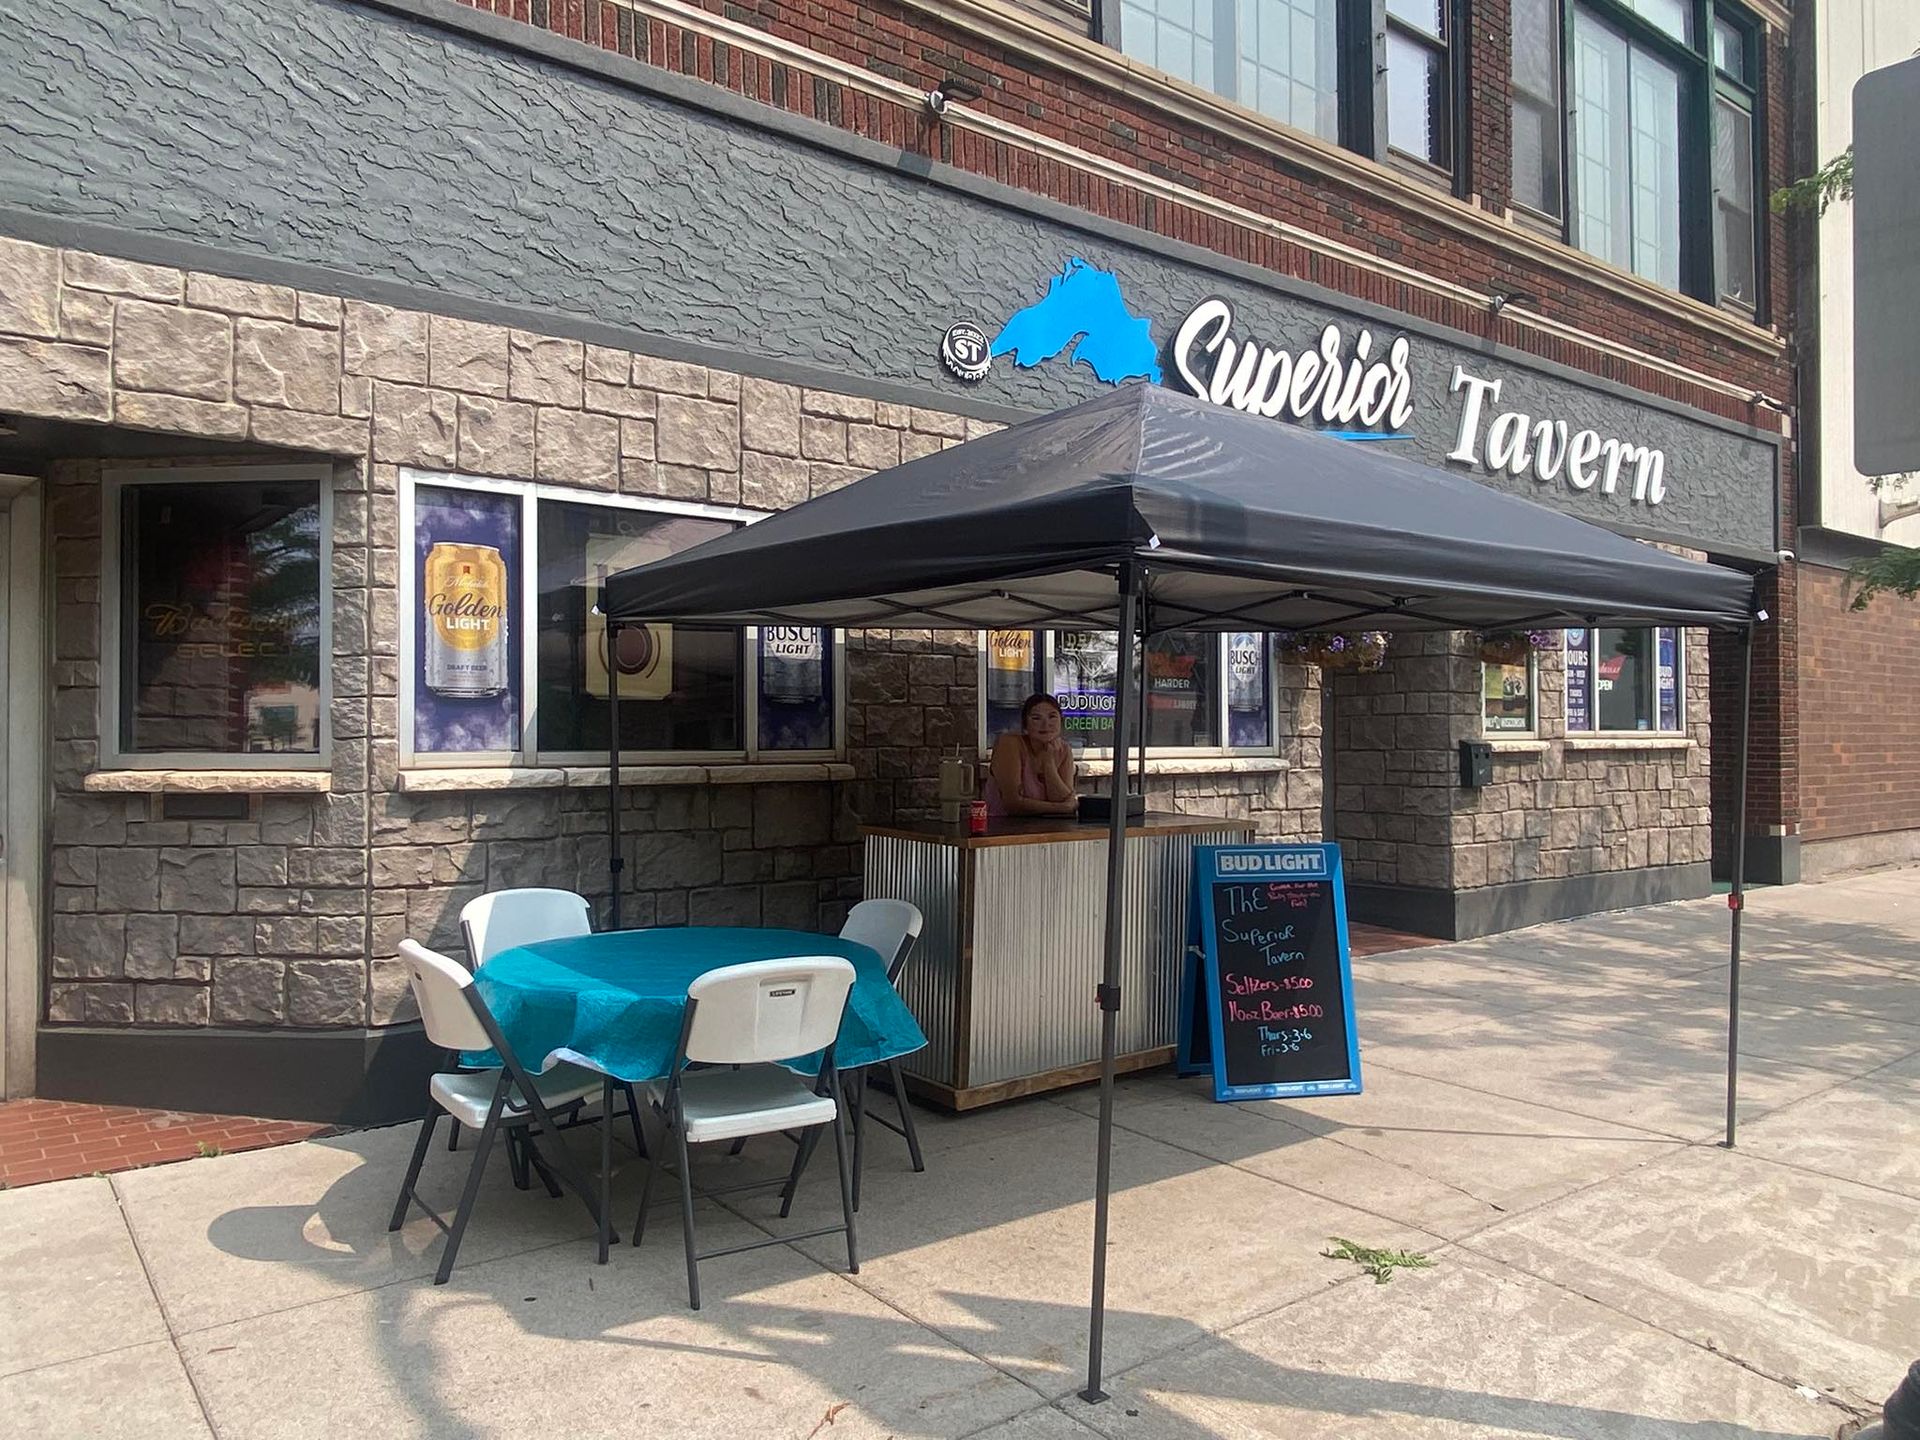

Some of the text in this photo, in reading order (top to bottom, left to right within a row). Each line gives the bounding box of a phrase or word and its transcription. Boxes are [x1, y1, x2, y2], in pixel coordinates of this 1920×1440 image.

[954, 338, 982, 362] ST
[1173, 298, 1414, 430] Superior
[1445, 364, 1666, 505] Tavern
[428, 592, 505, 619] Golden
[446, 617, 491, 631] LIGHT
[767, 626, 818, 644] BUSCH
[989, 630, 1031, 649] Golden
[775, 643, 811, 655] LIGHT
[999, 647, 1025, 658] LIGHT
[1568, 650, 1588, 666] OURS
[1235, 666, 1256, 676] LIGHT
[1154, 677, 1191, 689] HARDER
[1057, 694, 1117, 711] BUD LIGH
[1064, 717, 1115, 731] GREEN BA
[1220, 854, 1321, 872] BUD LIGHT
[1259, 942, 1305, 966] Tavern
